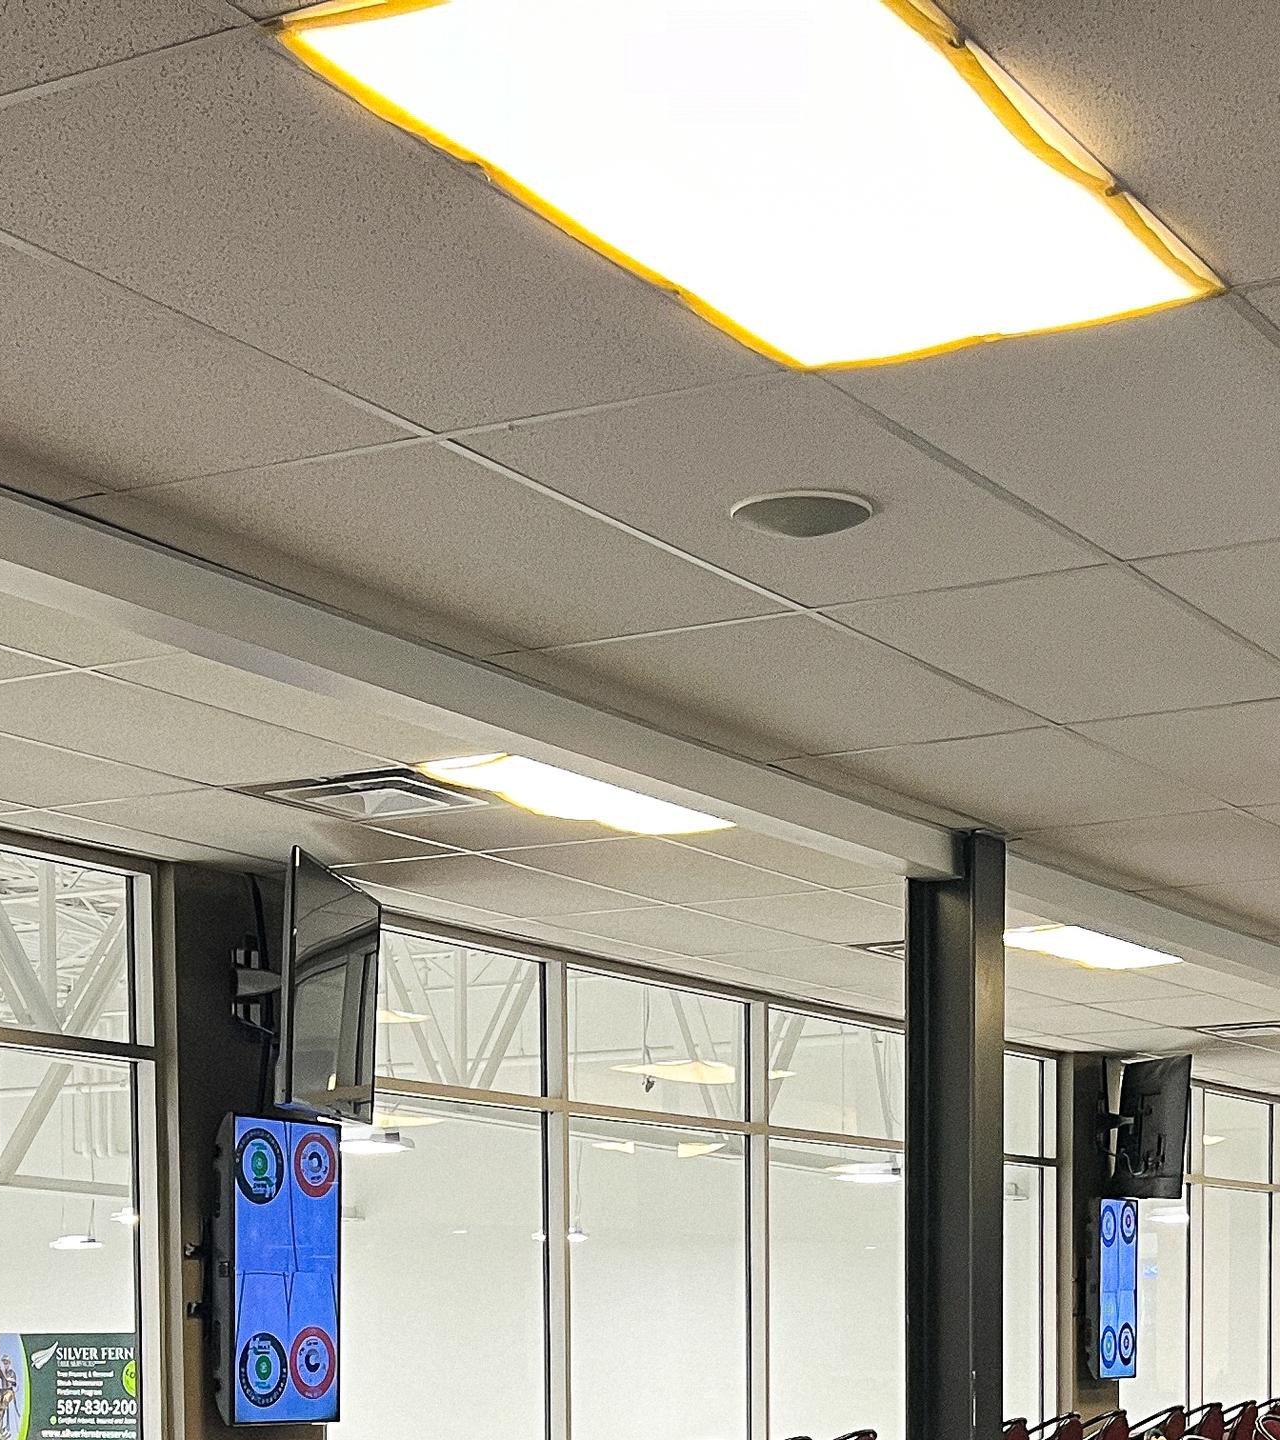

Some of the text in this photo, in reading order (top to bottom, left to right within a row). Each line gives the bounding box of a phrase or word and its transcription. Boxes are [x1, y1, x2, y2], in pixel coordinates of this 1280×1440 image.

[55, 1347, 134, 1360] SILVER FERN
[56, 1399, 137, 1415] 587-830-200
